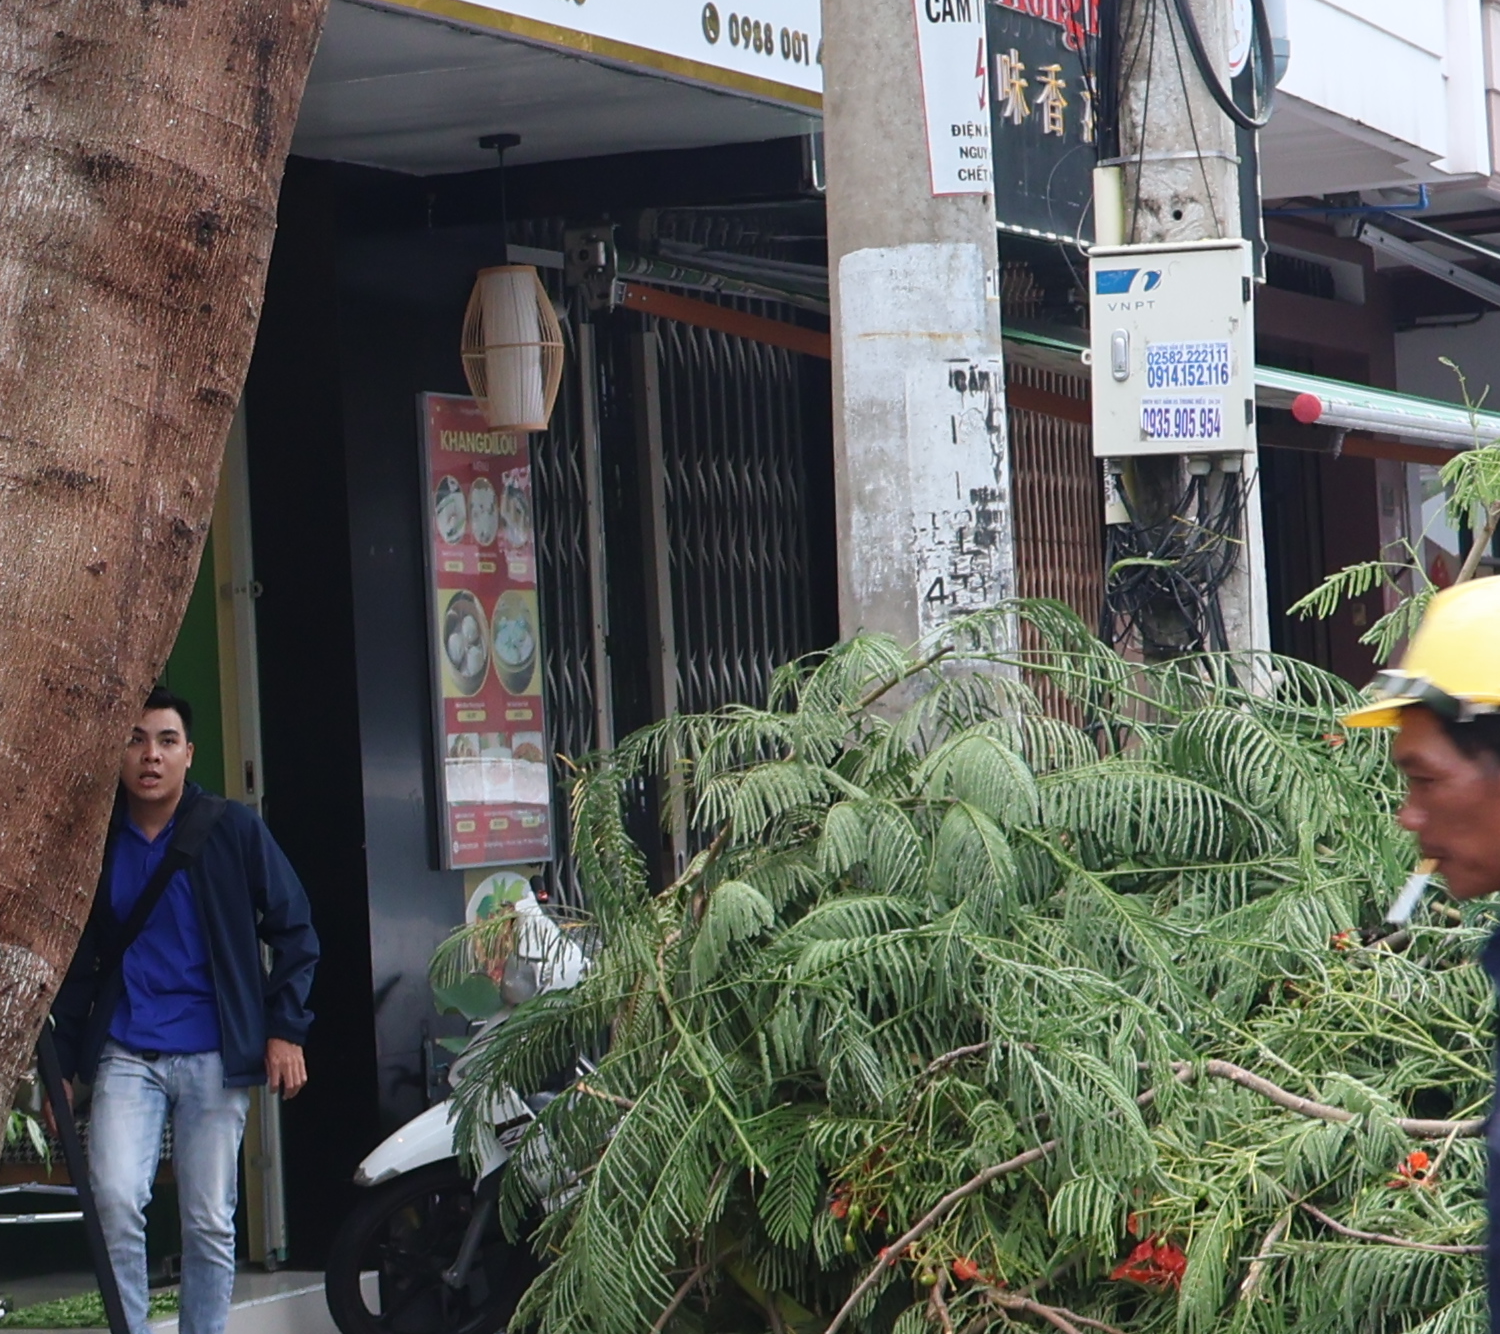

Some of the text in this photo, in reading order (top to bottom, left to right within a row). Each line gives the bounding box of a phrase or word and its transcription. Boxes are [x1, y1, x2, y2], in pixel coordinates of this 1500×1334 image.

[728, 12, 774, 56] 0988
[780, 26, 810, 66] 001
[951, 121, 982, 139] ĐIỆN
[1108, 301, 1156, 312] VNPT
[1147, 349, 1229, 365] 02582.222111
[1147, 363, 1229, 388] 0914.152.116
[1142, 407, 1221, 439] 0935.905.954
[440, 430, 517, 456] KHANGDILOU
